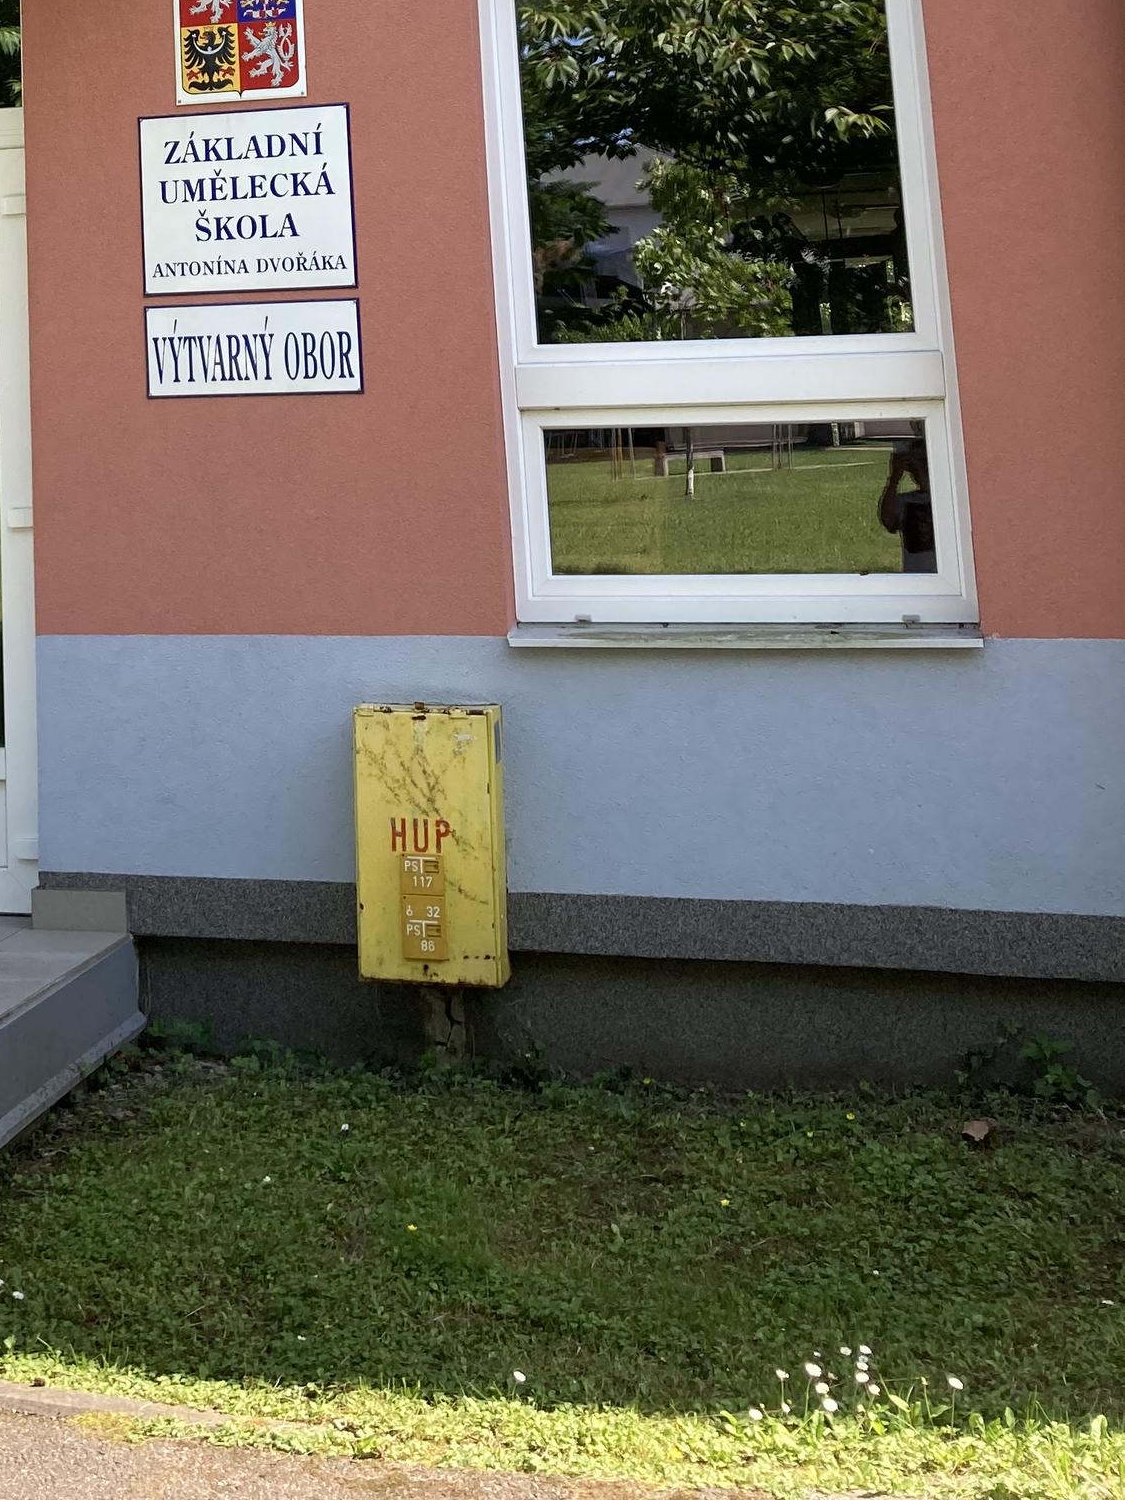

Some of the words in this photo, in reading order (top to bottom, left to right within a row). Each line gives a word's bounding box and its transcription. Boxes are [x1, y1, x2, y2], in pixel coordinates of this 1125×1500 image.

[163, 123, 324, 165] ZÁKLADNÍ
[159, 162, 336, 205] UMĚLECKÁ
[194, 209, 300, 243] ŠKOLA
[151, 254, 250, 279] ANTONÍNA
[255, 247, 348, 273] DVOŘÁKA
[151, 315, 275, 386] VÝTVARNÝ
[283, 329, 355, 382] OBOR
[390, 817, 450, 853] HUP
[412, 875, 433, 888] 117
[426, 906, 441, 918] 32
[420, 939, 436, 952] 86
